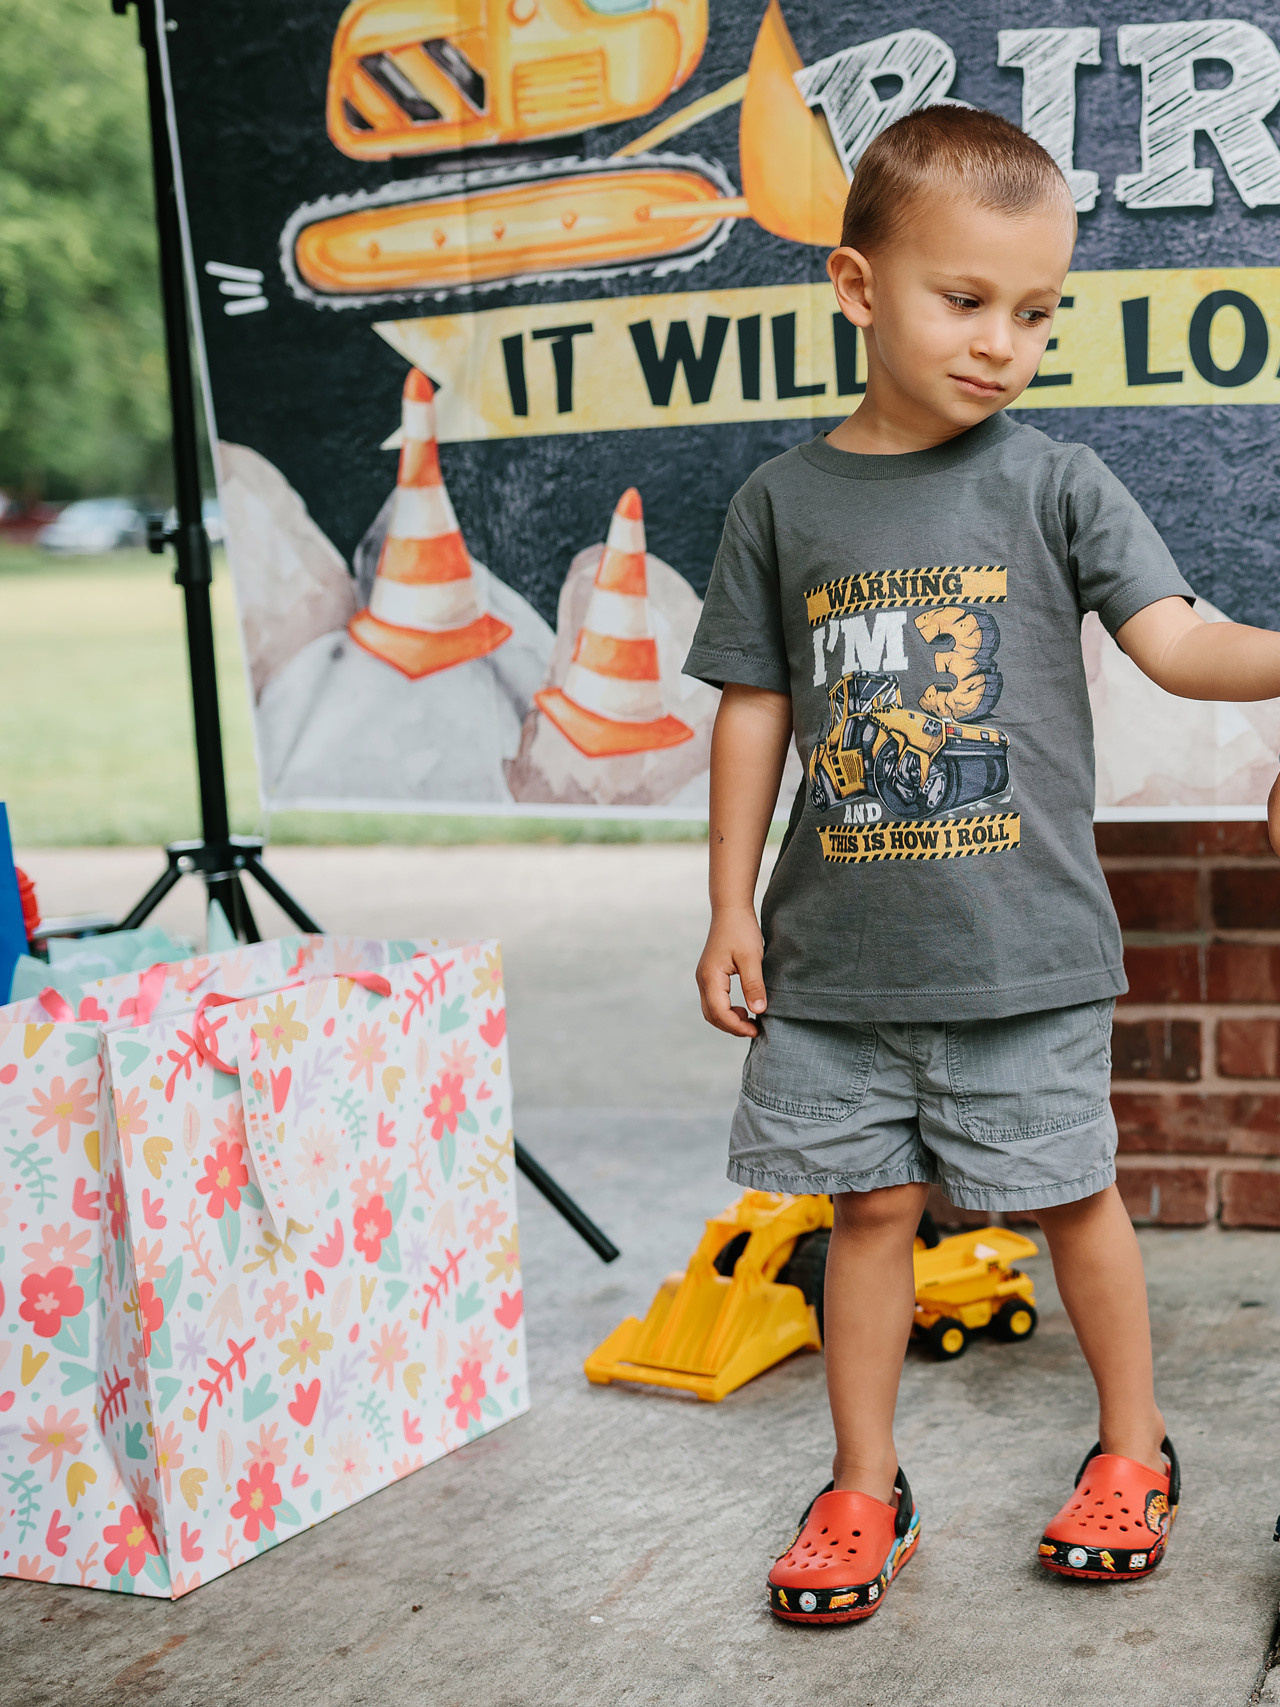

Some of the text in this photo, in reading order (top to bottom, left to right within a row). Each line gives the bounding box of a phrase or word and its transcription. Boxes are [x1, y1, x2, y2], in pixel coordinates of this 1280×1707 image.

[502, 323, 594, 416] IT
[826, 573, 963, 610] WARNING
[812, 604, 1003, 724] I'M 3
[843, 802, 882, 823] AND
[829, 823, 1010, 854] THIS IS HOW I ROLL
[1128, 1552, 1148, 1570] 95
